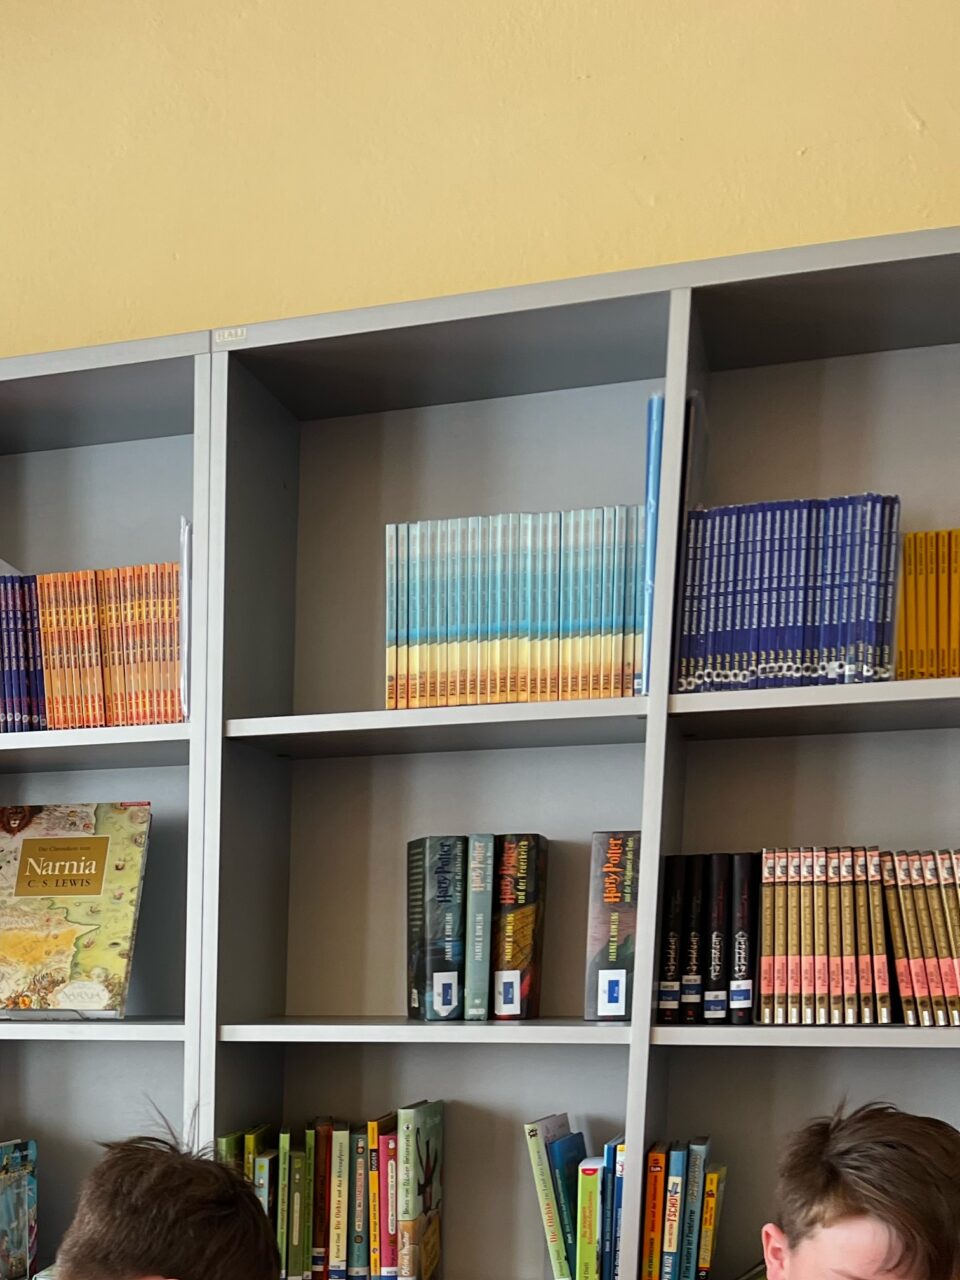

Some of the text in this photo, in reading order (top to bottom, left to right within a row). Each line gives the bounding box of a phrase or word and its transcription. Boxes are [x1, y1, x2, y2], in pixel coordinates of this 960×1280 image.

[25, 857, 96, 875] Narnia
[55, 879, 91, 887] LEWIS
[434, 842, 453, 903] Harry Potter
[471, 841, 485, 891] Harry Potter
[499, 841, 517, 904] Harry Potter
[518, 841, 528, 903] und der Feuerkelch
[602, 838, 623, 903] Harry Potter
[445, 912, 453, 935] ROWLING
[474, 912, 483, 960] JOANNE ROWLING
[505, 913, 515, 960] JOANNE ROWLING
[609, 912, 619, 961] JOANNE ROWLING
[544, 1203, 557, 1227] Olchis
[667, 1195, 678, 1222] TSCHO!
[549, 1229, 558, 1243] Die
[663, 1255, 673, 1272] MAUZ
